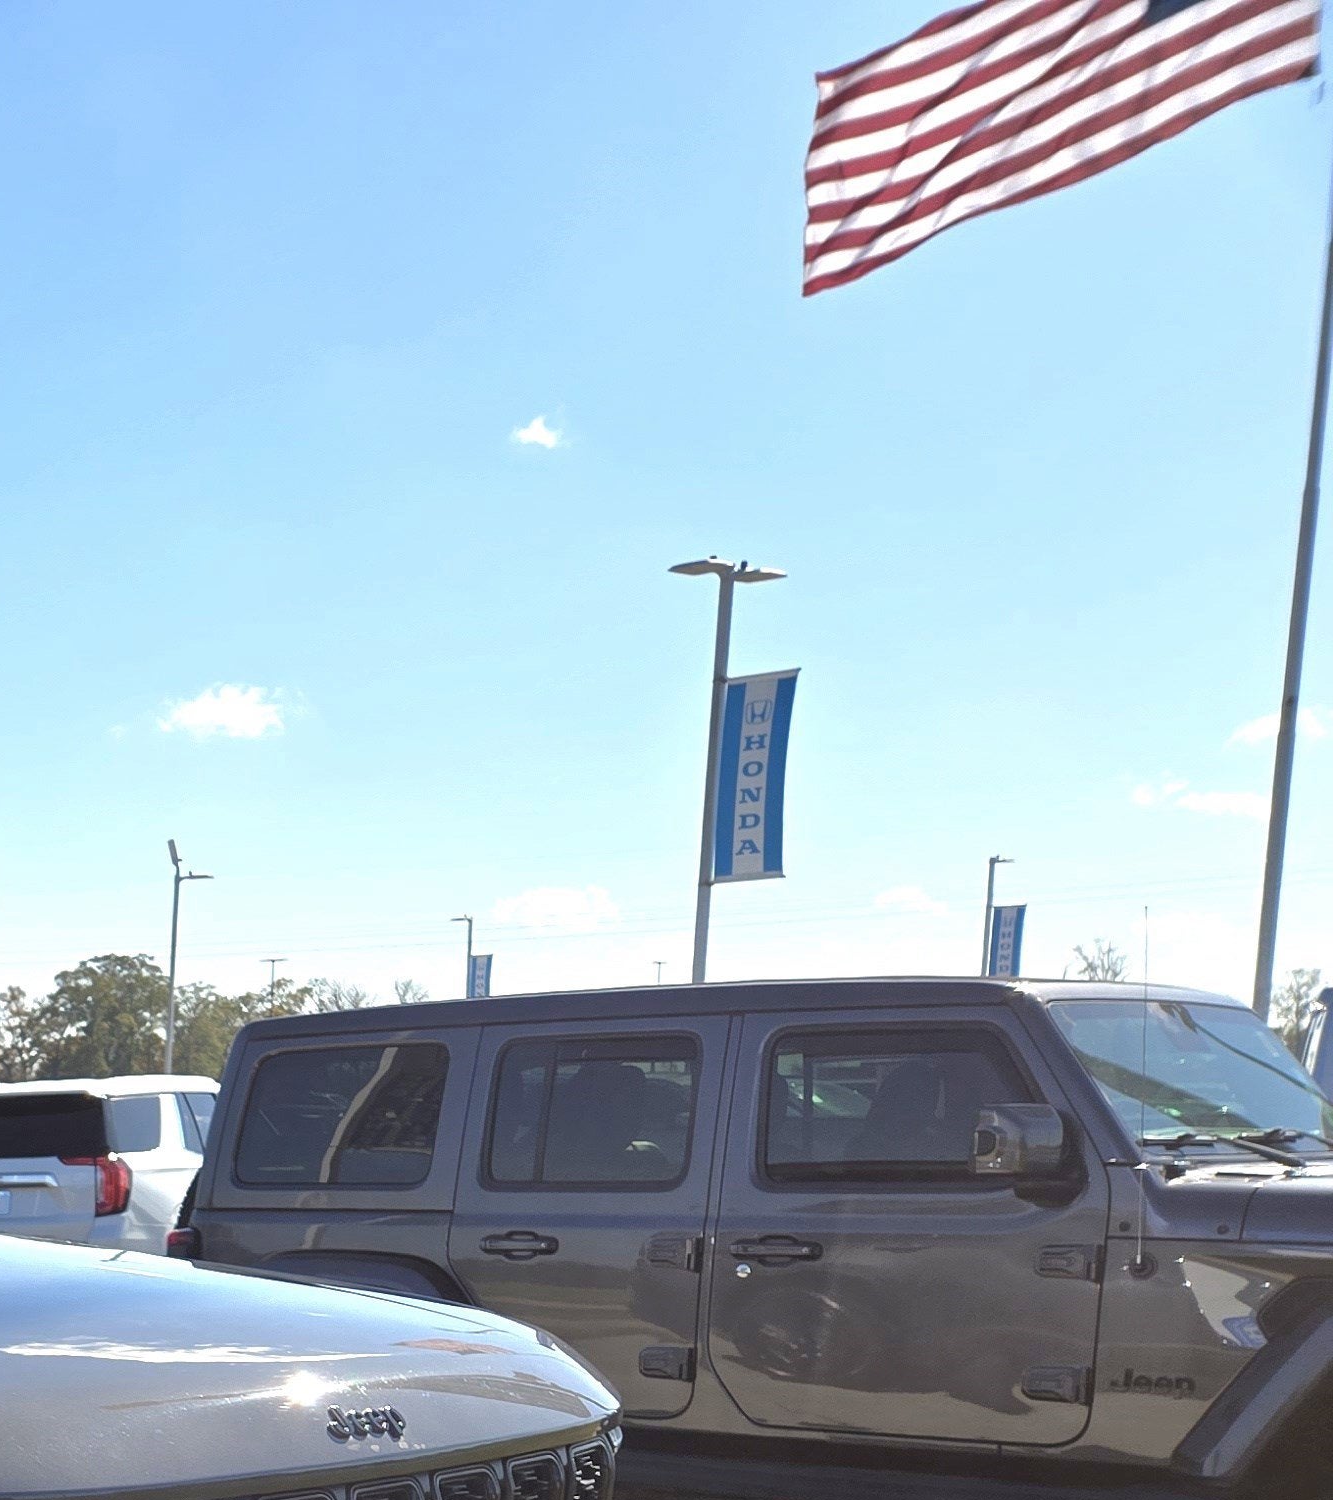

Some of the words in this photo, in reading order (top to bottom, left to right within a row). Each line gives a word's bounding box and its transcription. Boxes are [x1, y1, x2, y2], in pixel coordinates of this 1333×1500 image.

[736, 733, 767, 856] HONDA
[1110, 1368, 1195, 1400] Jeep
[326, 1404, 406, 1444] Jeep
